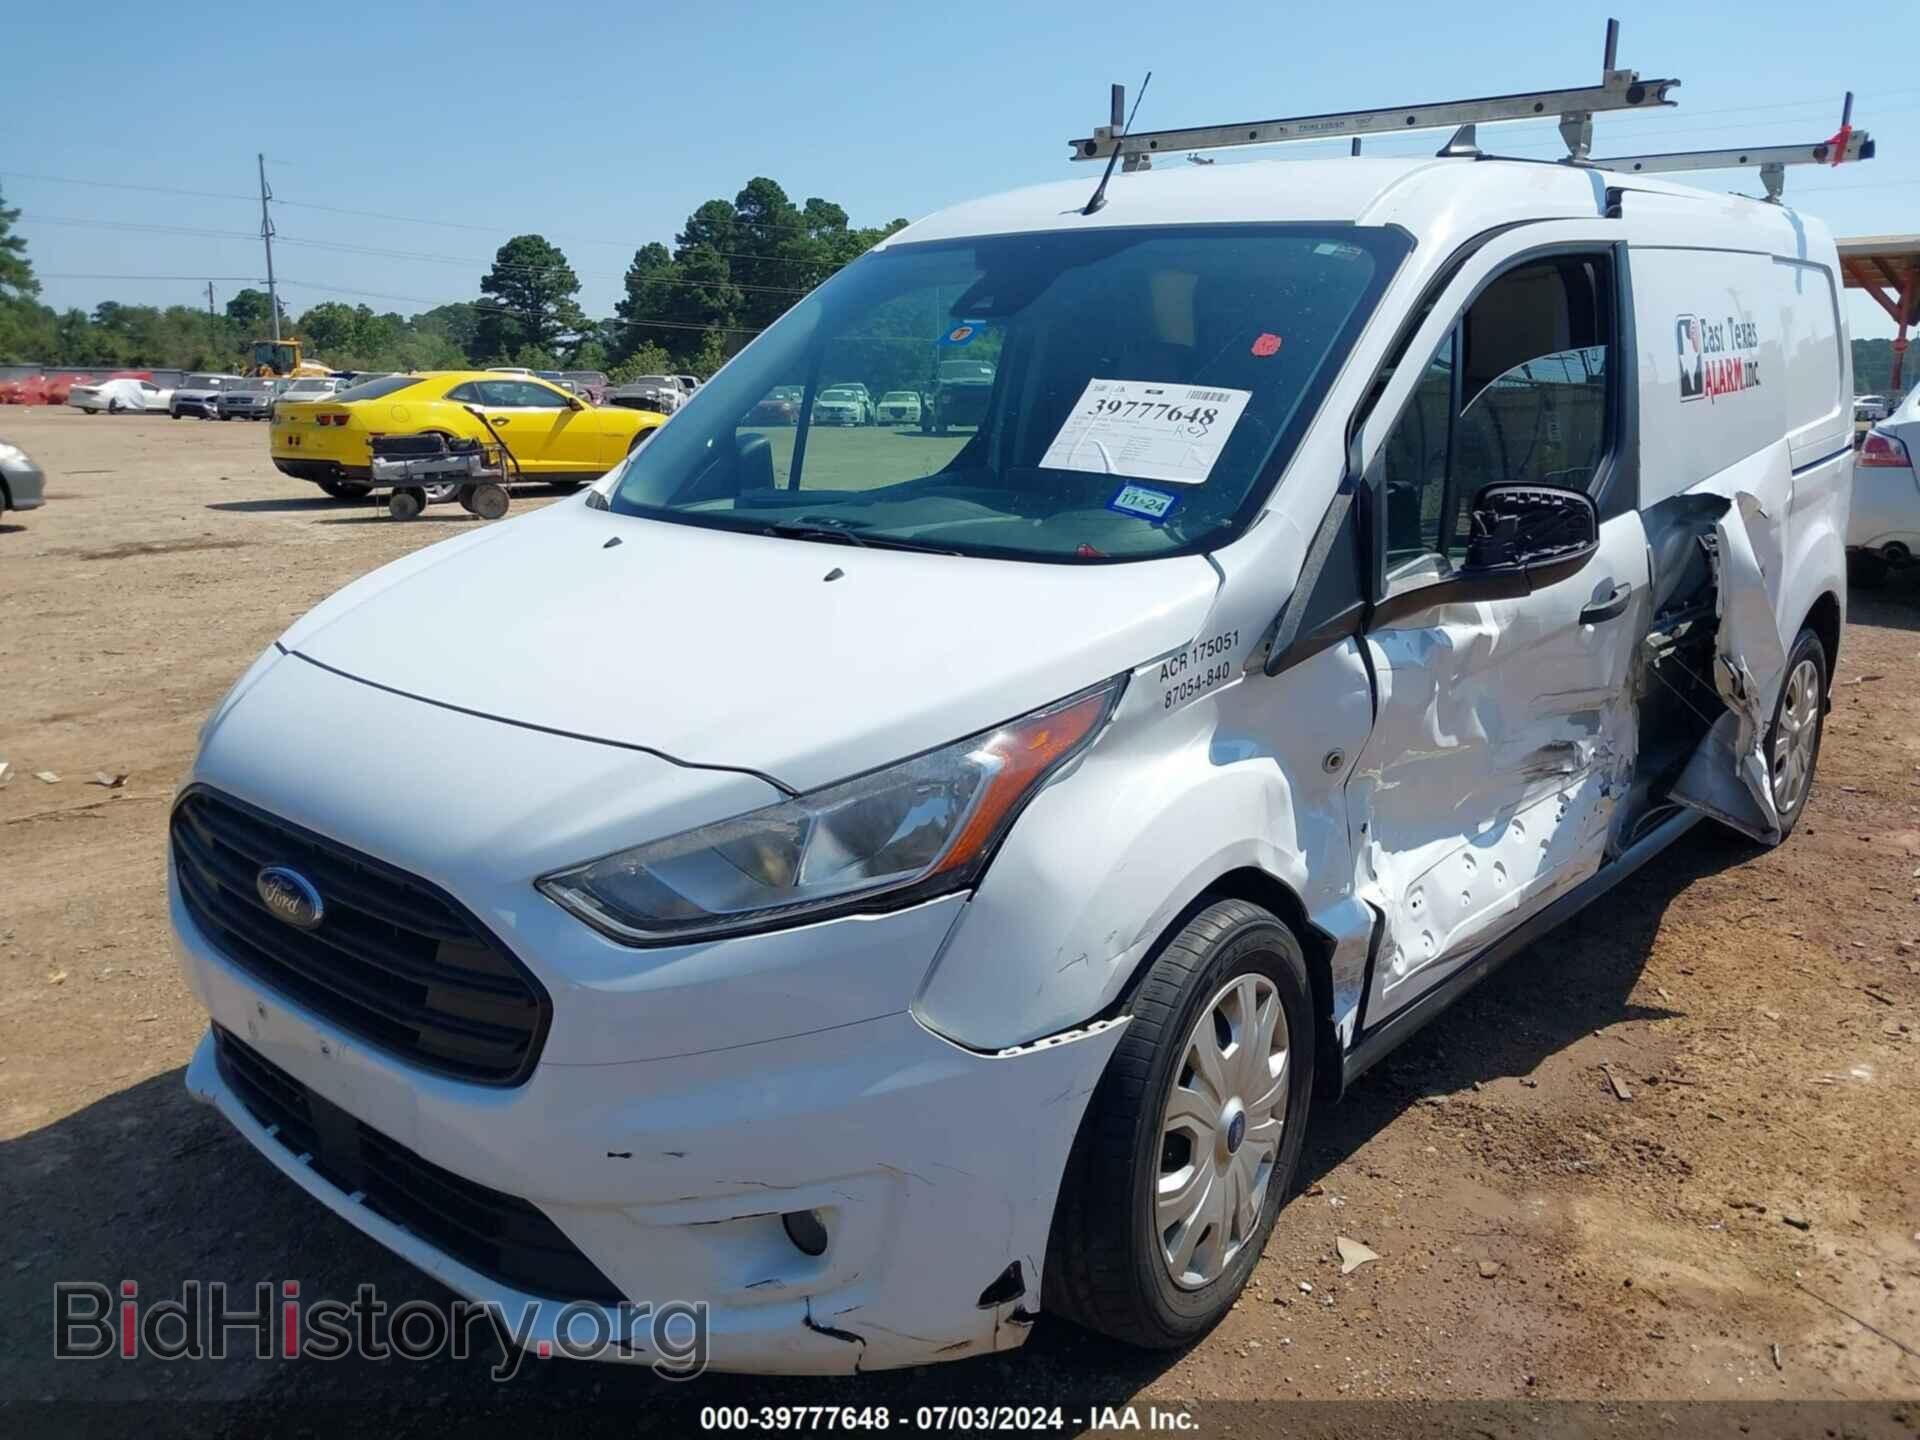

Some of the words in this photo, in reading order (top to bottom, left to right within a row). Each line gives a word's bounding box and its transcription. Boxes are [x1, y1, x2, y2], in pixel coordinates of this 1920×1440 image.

[1699, 318, 1725, 353] East
[1727, 317, 1758, 350] Texas
[1088, 399, 1218, 425] 39777648
[1159, 652, 1188, 683] ACR
[1192, 629, 1239, 664] 175051
[1164, 661, 1230, 709] 87054-840
